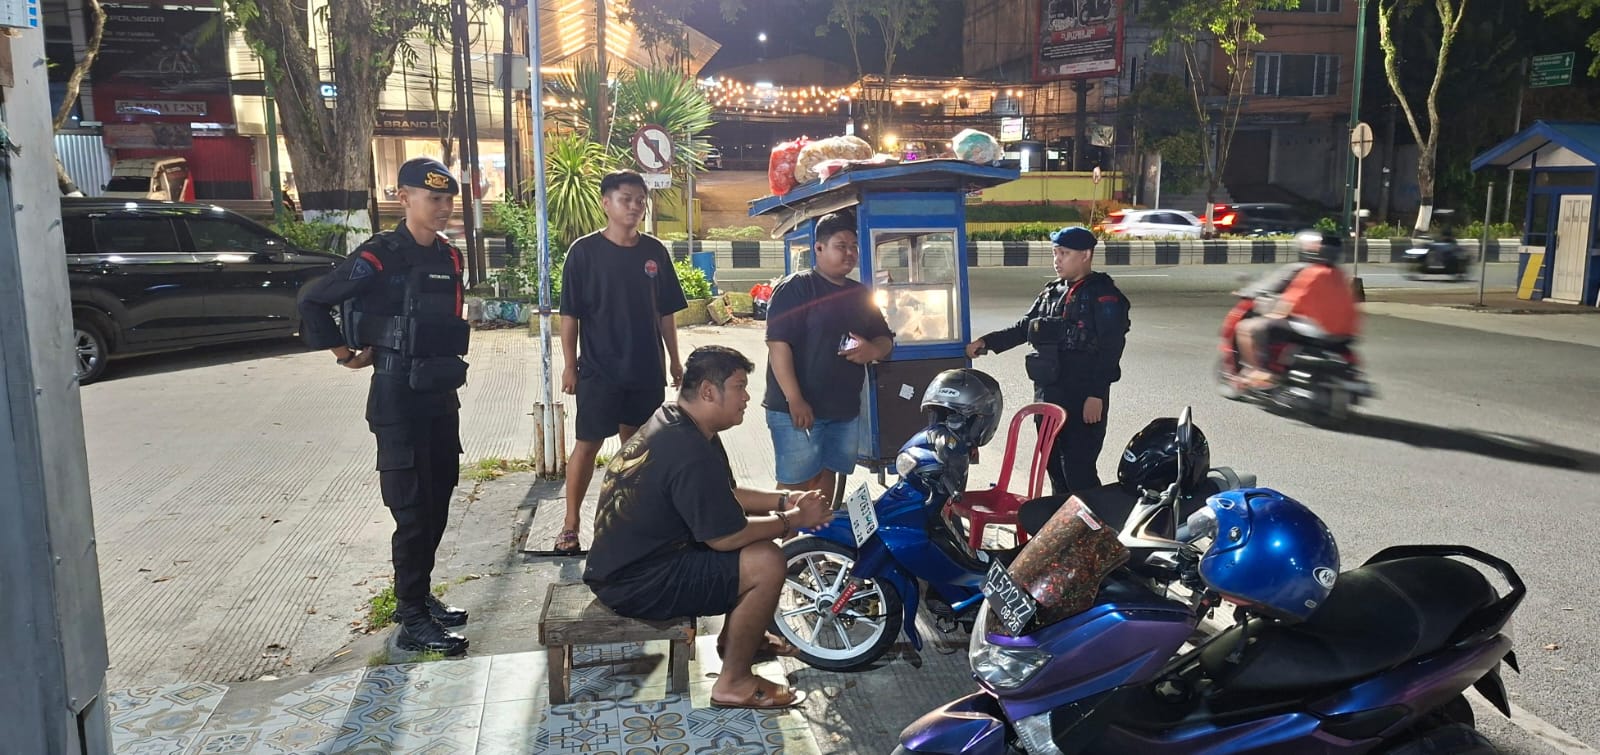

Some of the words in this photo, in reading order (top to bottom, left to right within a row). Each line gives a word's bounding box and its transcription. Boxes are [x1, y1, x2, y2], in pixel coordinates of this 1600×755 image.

[383, 120, 428, 129] BRAND
[987, 561, 1002, 583] KT
[995, 574, 1019, 608] 5212
[1012, 597, 1032, 624] ZZ
